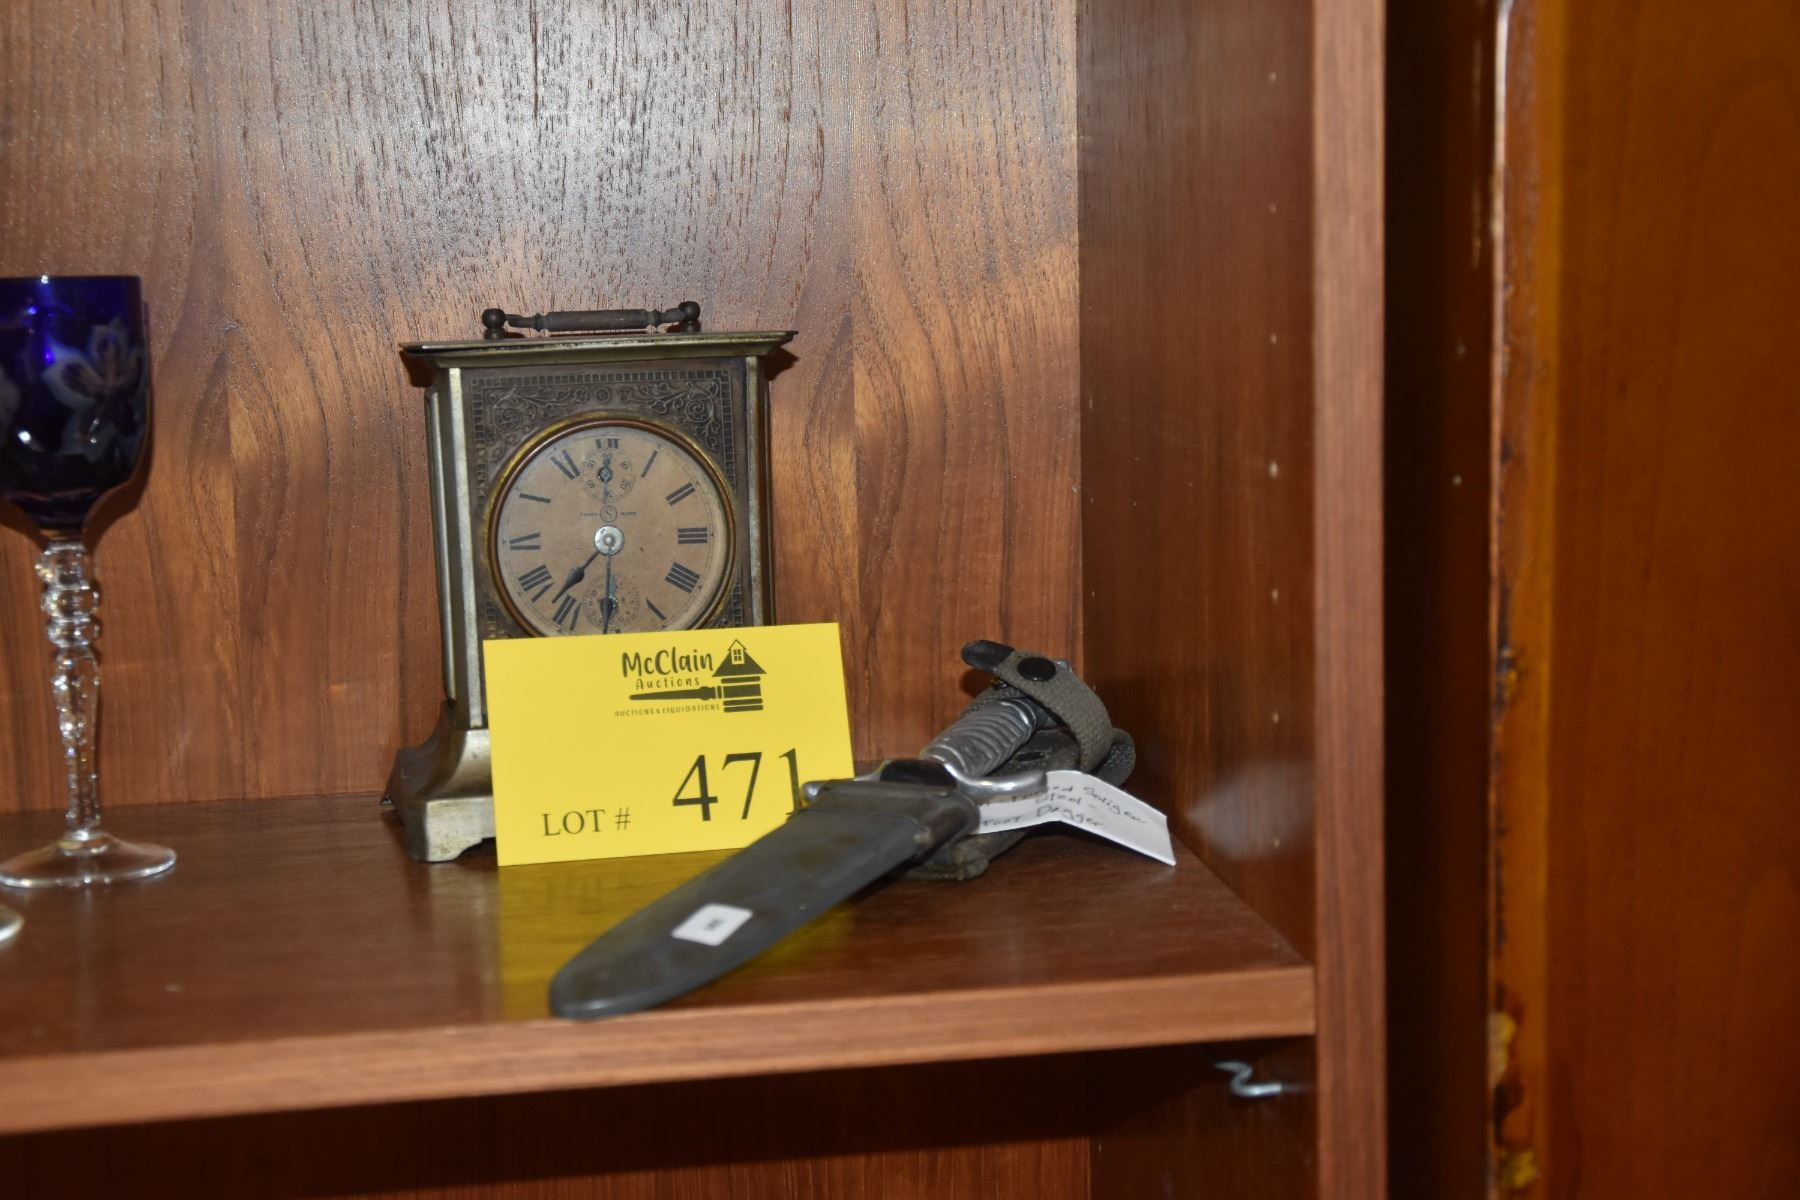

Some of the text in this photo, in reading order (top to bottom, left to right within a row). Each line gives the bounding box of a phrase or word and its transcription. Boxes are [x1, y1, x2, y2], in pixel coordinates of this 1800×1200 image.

[621, 646, 714, 678] McClain
[635, 677, 700, 690] Auctions
[614, 708, 654, 717] AUCTIONS
[662, 703, 720, 714] LIQUIDATIONS
[542, 748, 801, 836] LOT # 471
